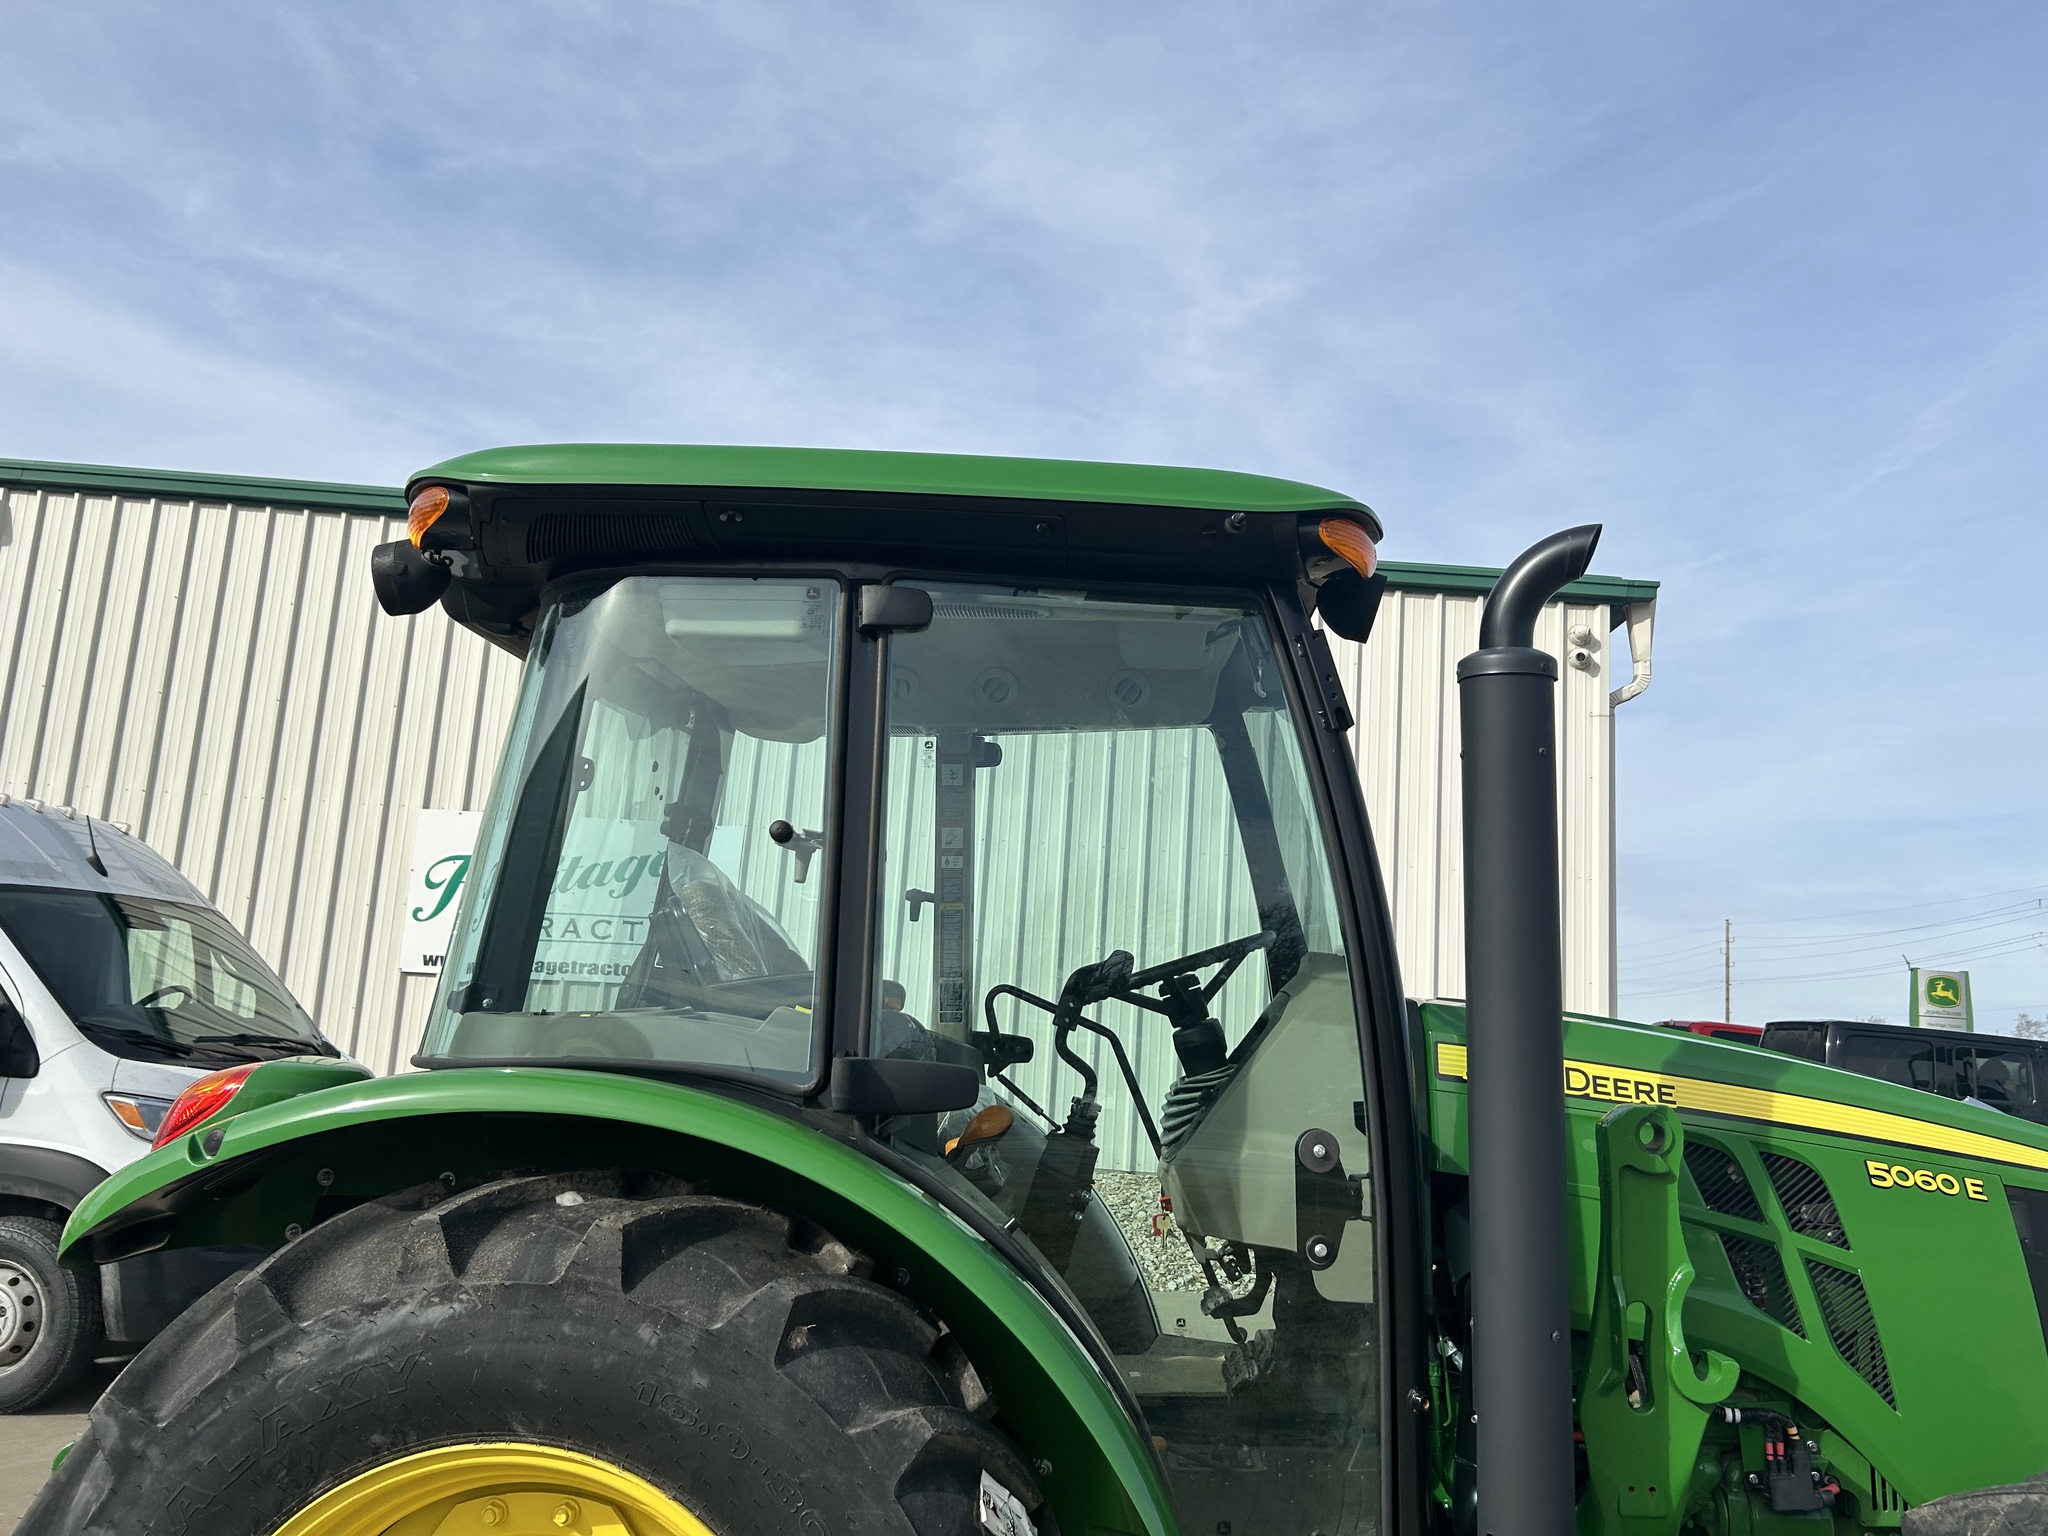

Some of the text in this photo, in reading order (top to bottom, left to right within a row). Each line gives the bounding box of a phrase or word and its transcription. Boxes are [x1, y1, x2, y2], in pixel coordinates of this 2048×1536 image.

[1565, 1067, 1677, 1105] DEERE
[1864, 1159, 1989, 1202] 5060 E
[158, 1350, 426, 1536] ALAXY
